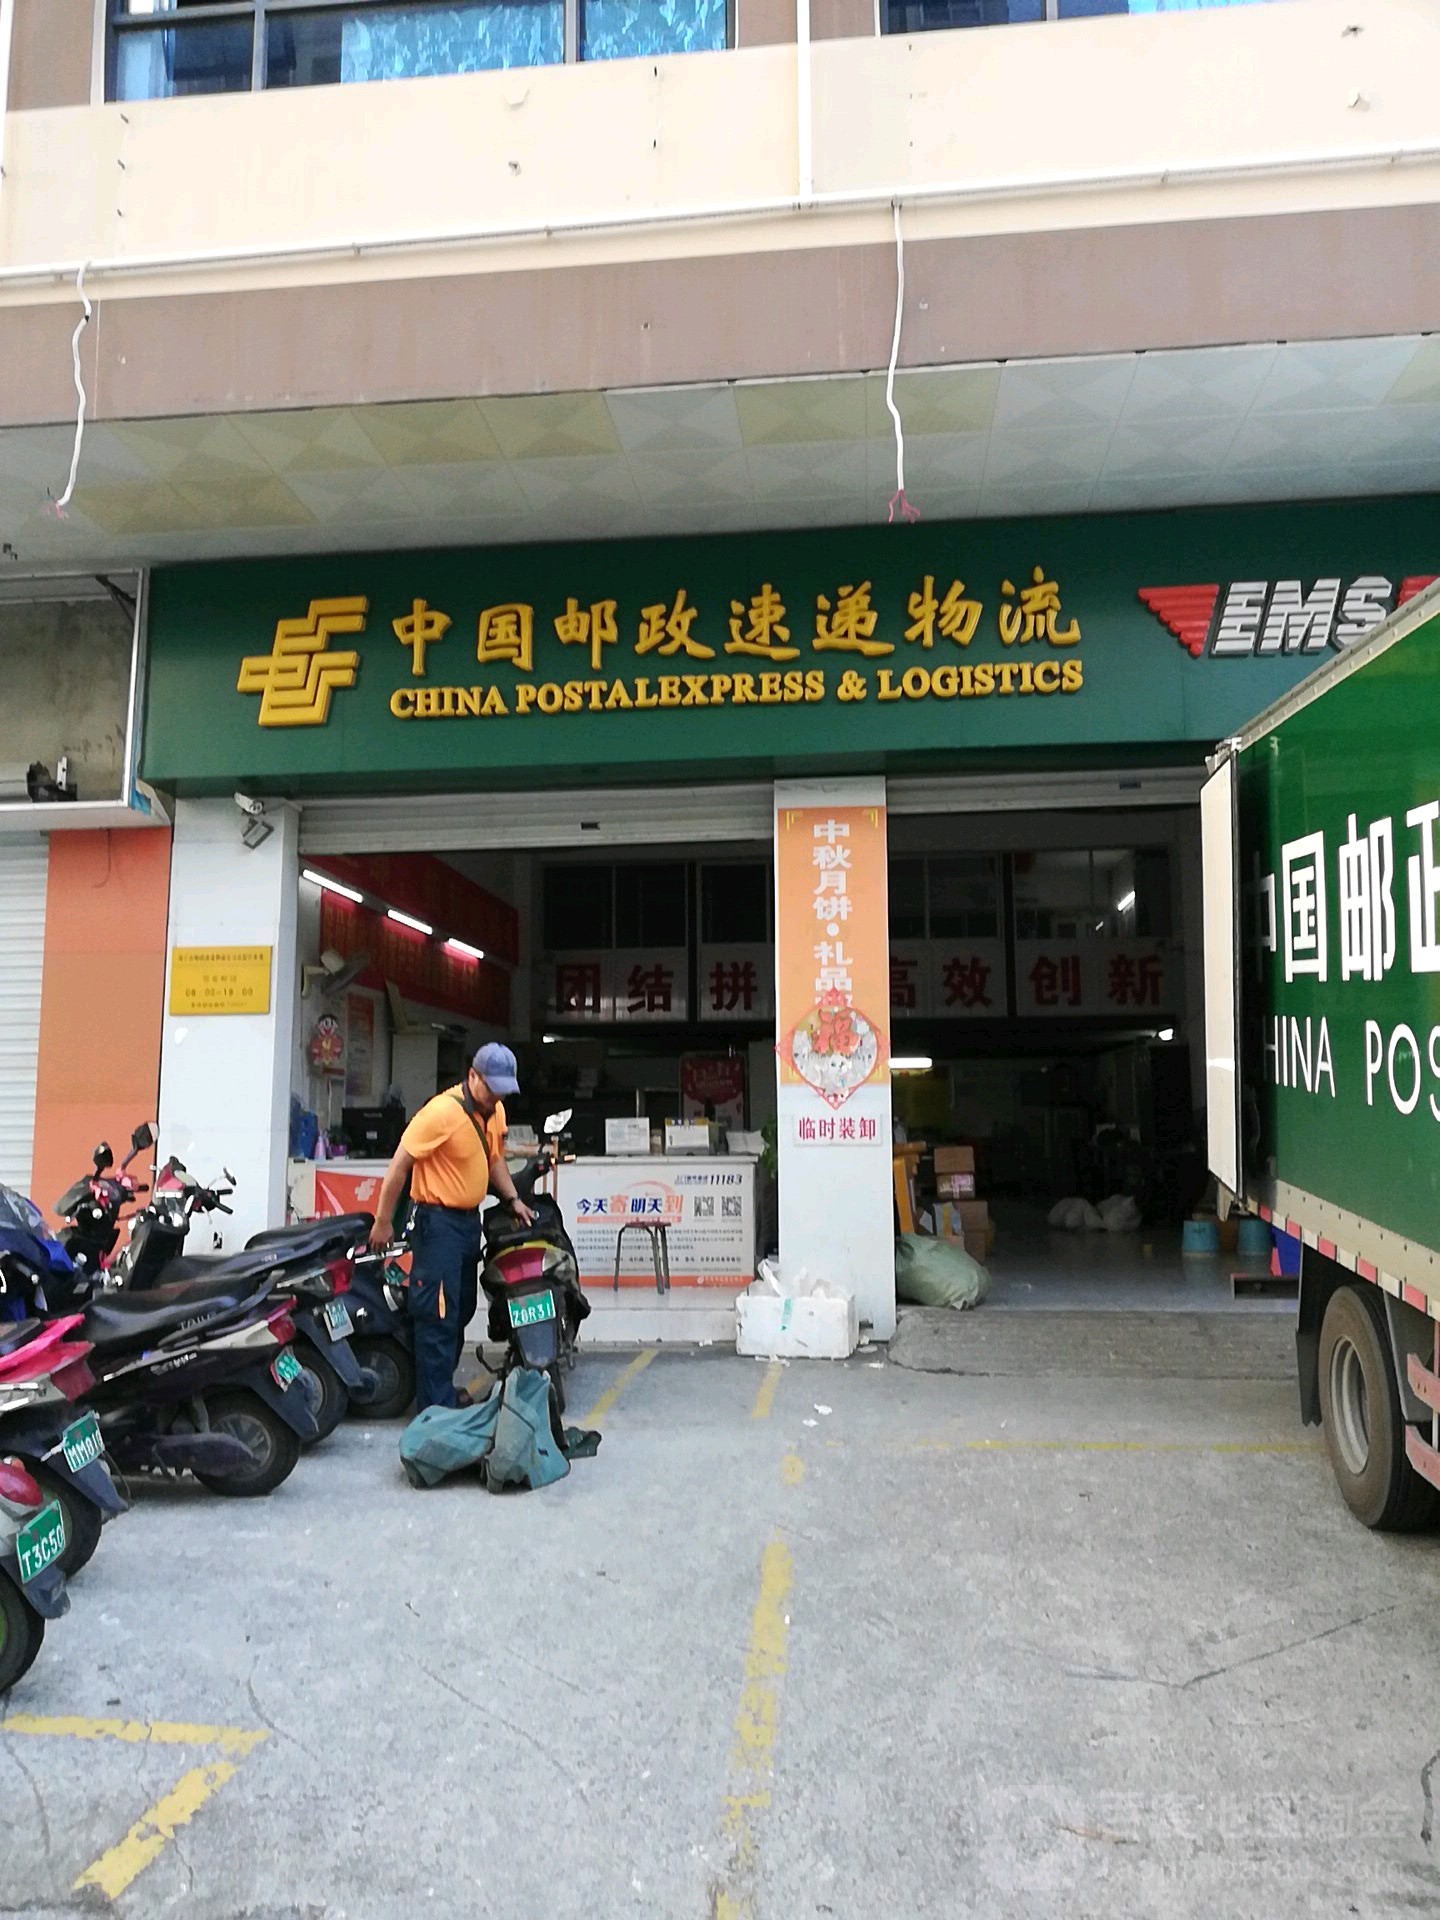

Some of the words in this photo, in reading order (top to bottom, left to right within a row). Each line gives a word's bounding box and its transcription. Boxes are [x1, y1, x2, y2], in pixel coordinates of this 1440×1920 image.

[391, 566, 1081, 677] 中国邮政速递物流
[1210, 576, 1393, 657] EMS
[389, 685, 509, 719] CHINA
[837, 669, 867, 702] &
[877, 659, 1084, 701] LOGISTICS
[799, 1115, 876, 1140] 临时装卸
